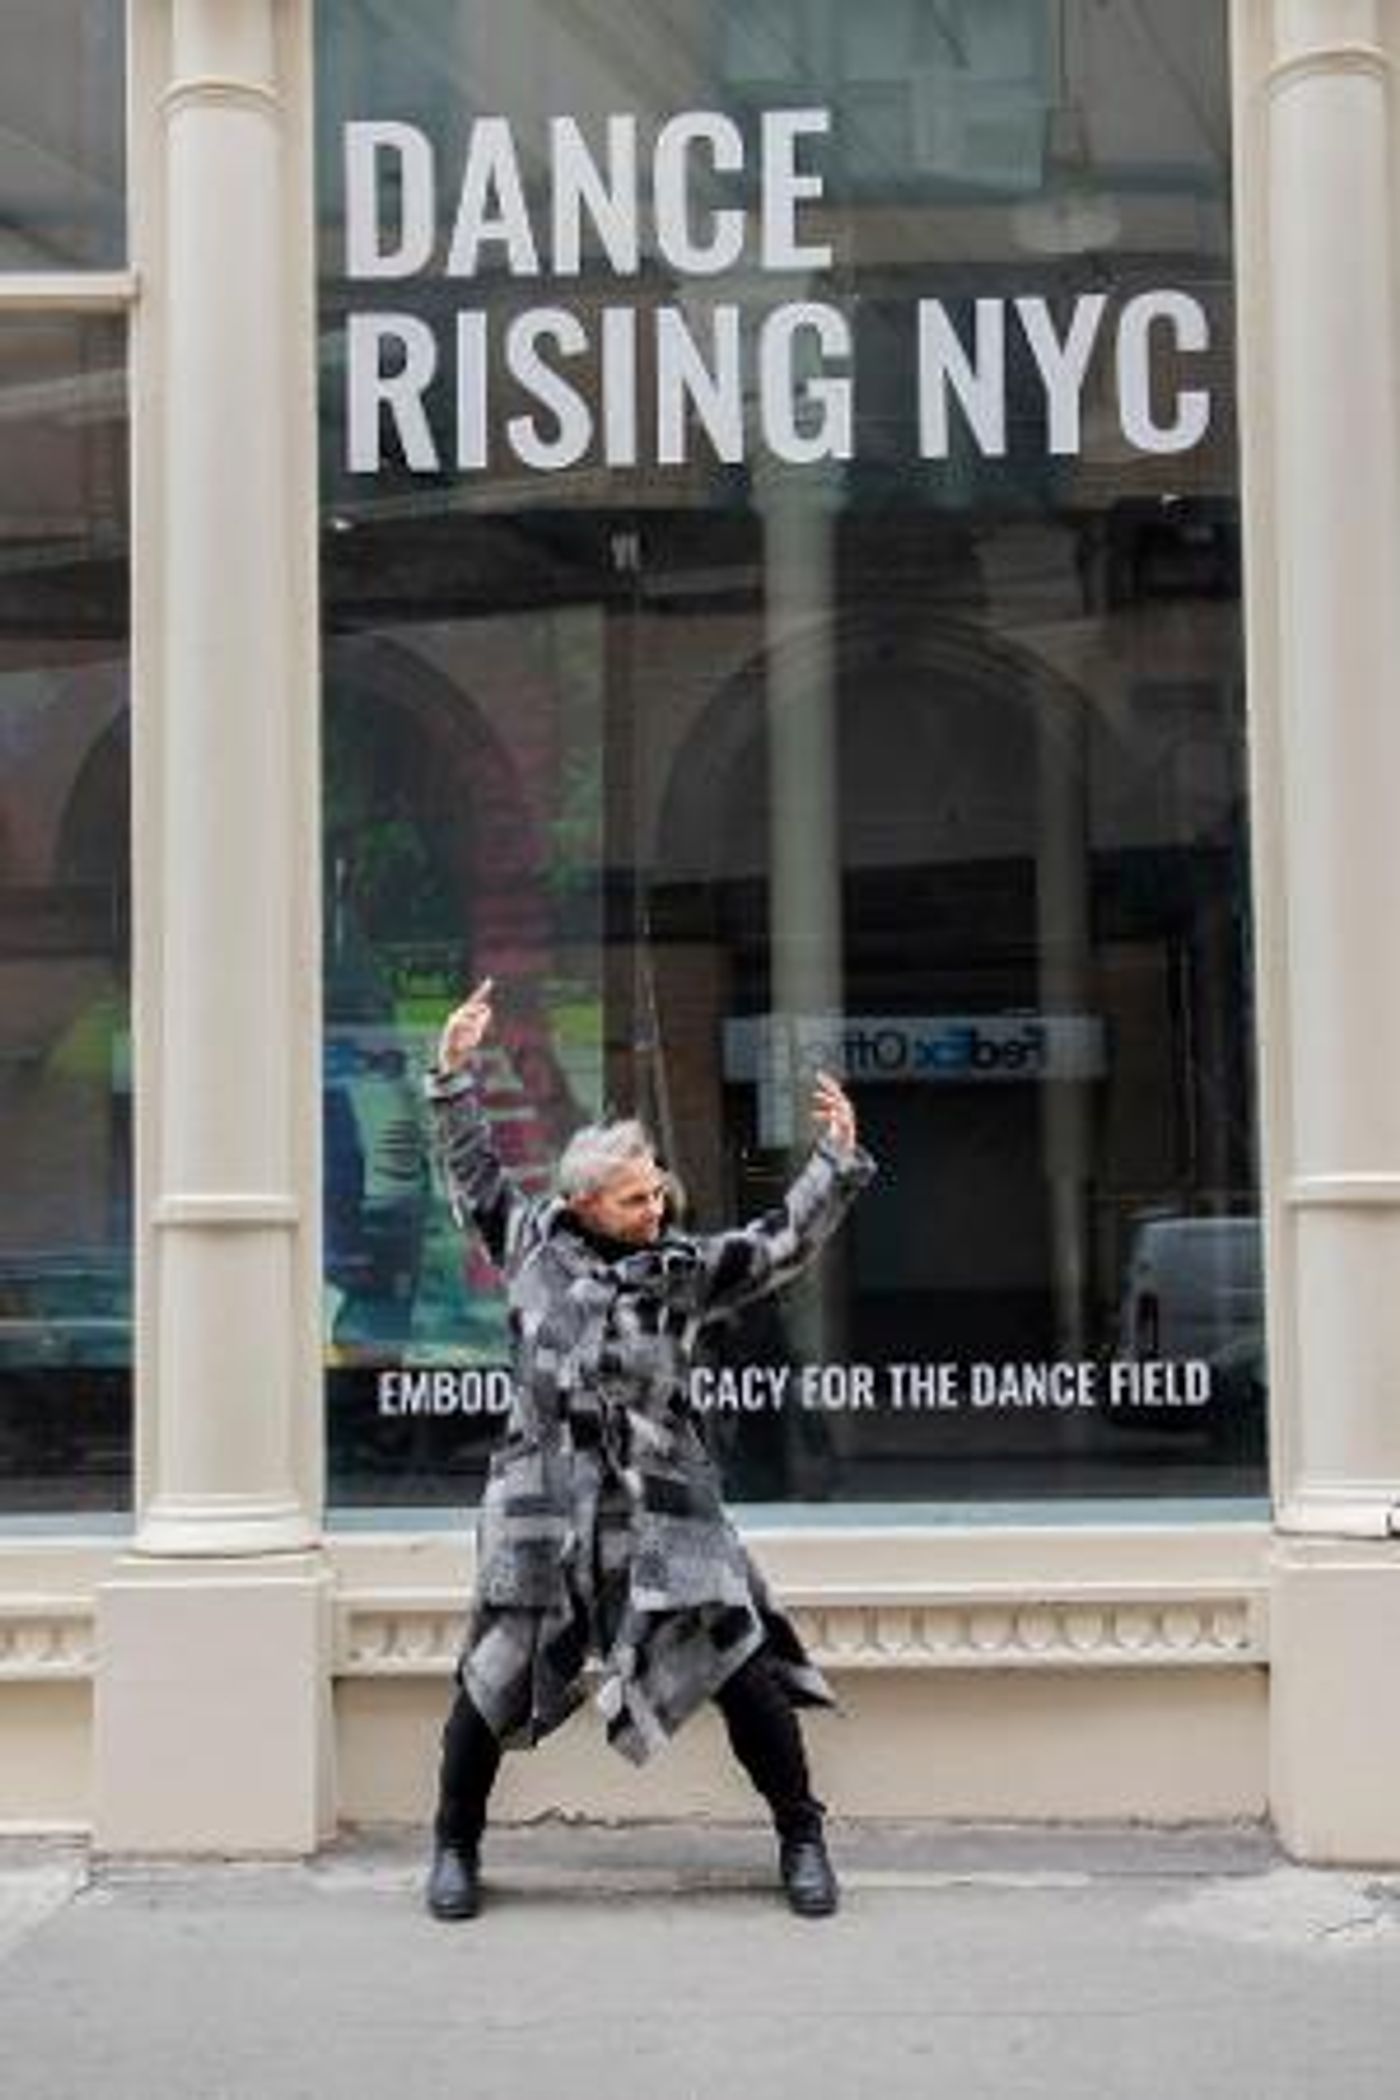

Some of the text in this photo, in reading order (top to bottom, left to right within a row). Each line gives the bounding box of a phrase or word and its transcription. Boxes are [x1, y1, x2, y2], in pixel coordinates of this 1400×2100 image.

[344, 109, 833, 279] DANCE
[346, 290, 1210, 473] RISING NYC
[378, 1359, 1211, 1415] EMBOD CACY FOR THE DANCE FIELD
